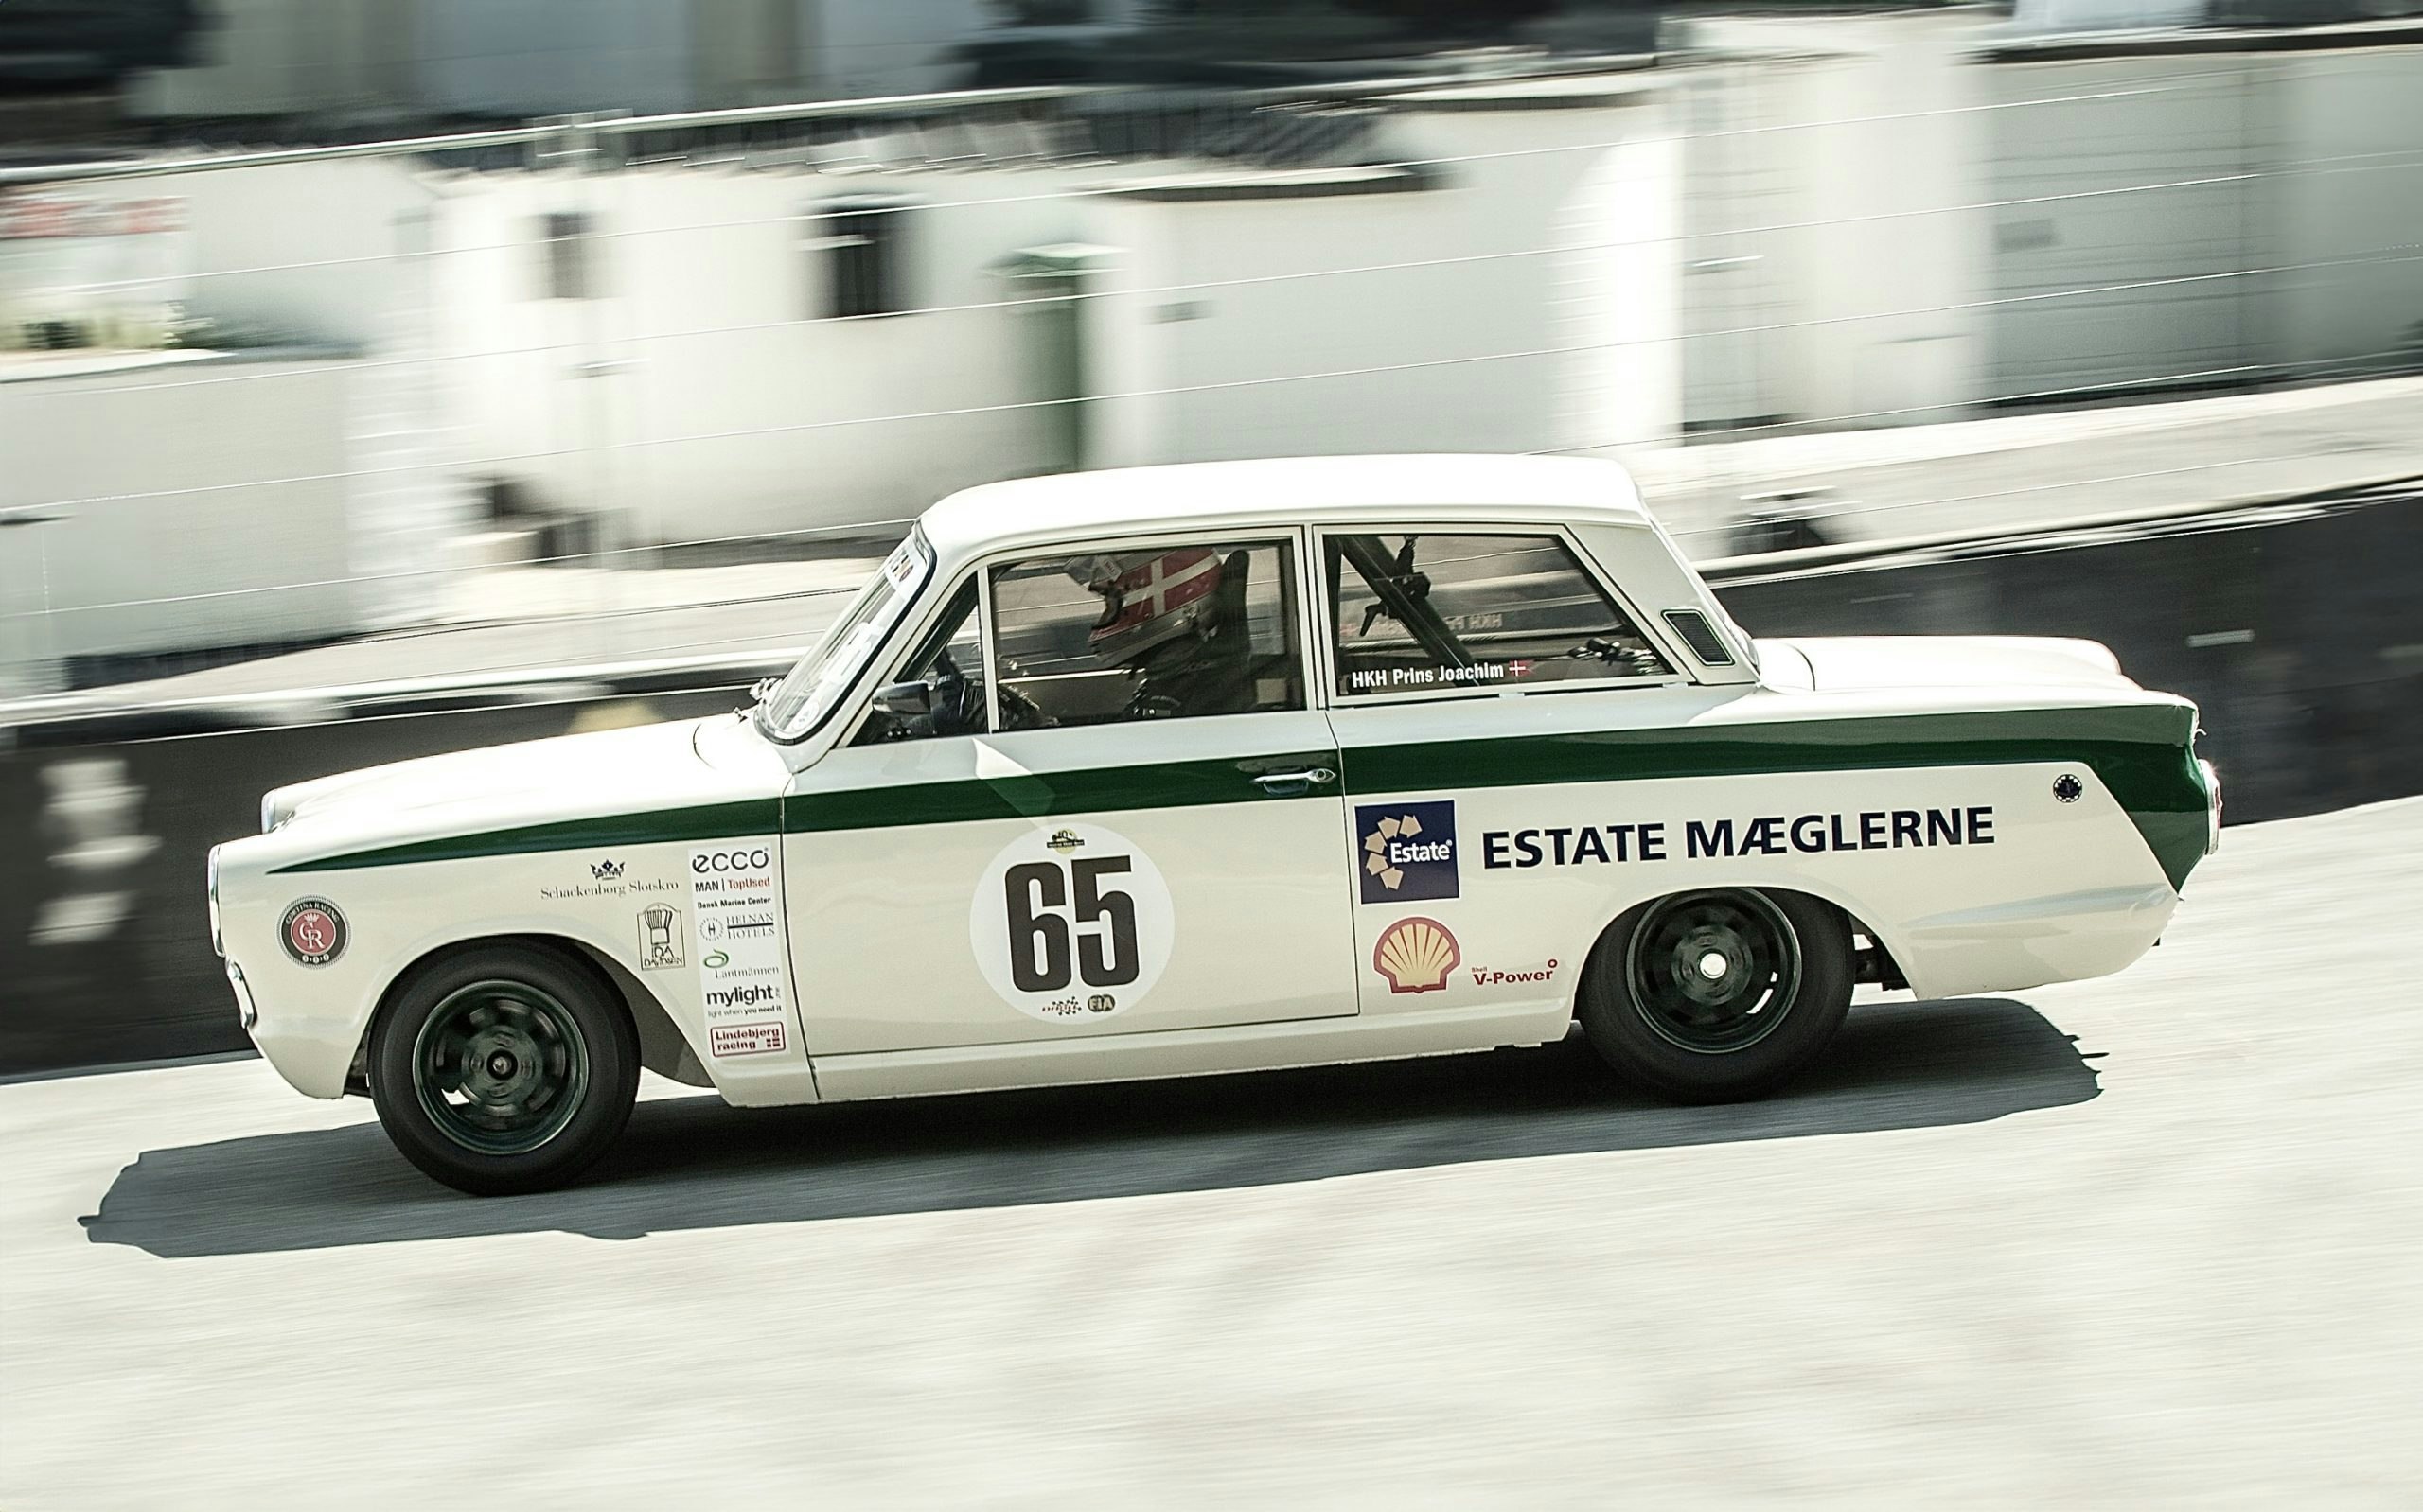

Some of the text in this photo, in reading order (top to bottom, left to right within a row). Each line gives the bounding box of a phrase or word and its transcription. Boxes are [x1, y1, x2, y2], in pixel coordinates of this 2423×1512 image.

[1352, 662, 1504, 688] HKH Prins Joachim
[1482, 806, 1995, 870] ESTATE MÆGLERNE
[1390, 840, 1451, 864] Estate
[540, 878, 679, 900] Schackenborg Slotskro
[695, 876, 771, 892] MAN TopUsed
[698, 897, 771, 909] Dansk Marine Center
[1005, 854, 1140, 993] 65
[651, 945, 675, 958] IDA
[715, 966, 780, 979] Lantmännen
[1473, 970, 1554, 985] V-Power
[706, 984, 774, 1007] mylight
[1088, 996, 1114, 1011] FIA
[708, 1010, 722, 1019] light
[744, 1007, 757, 1015] you
[716, 1028, 780, 1042] Lindebjerg
[716, 1041, 756, 1052] racing
